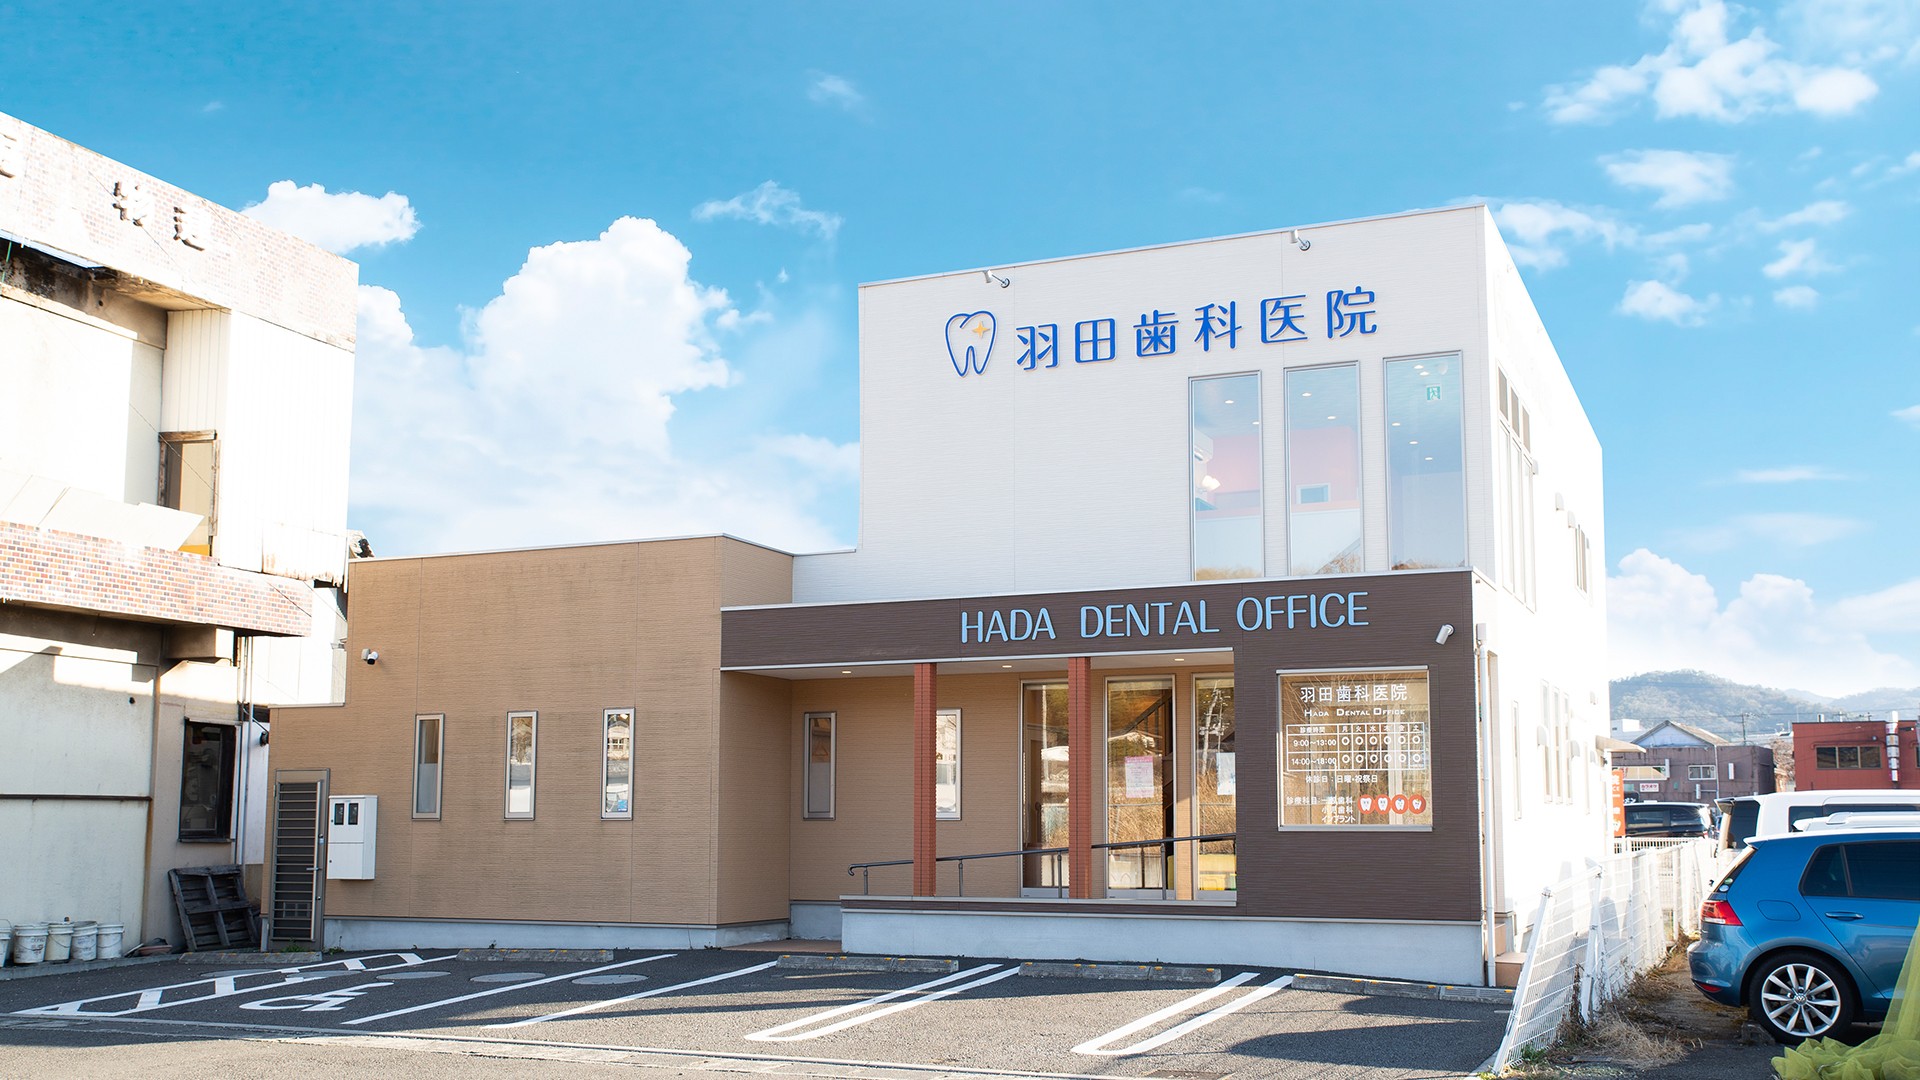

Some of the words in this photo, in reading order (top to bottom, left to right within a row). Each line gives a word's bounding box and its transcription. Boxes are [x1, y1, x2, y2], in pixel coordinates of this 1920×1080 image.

[1016, 285, 1378, 371] 羽田歯科医院
[961, 607, 1056, 643] HADA
[1080, 600, 1218, 638] DENTAL
[1236, 591, 1369, 631] OFFICE
[1300, 684, 1408, 703] 羽田歯科医院
